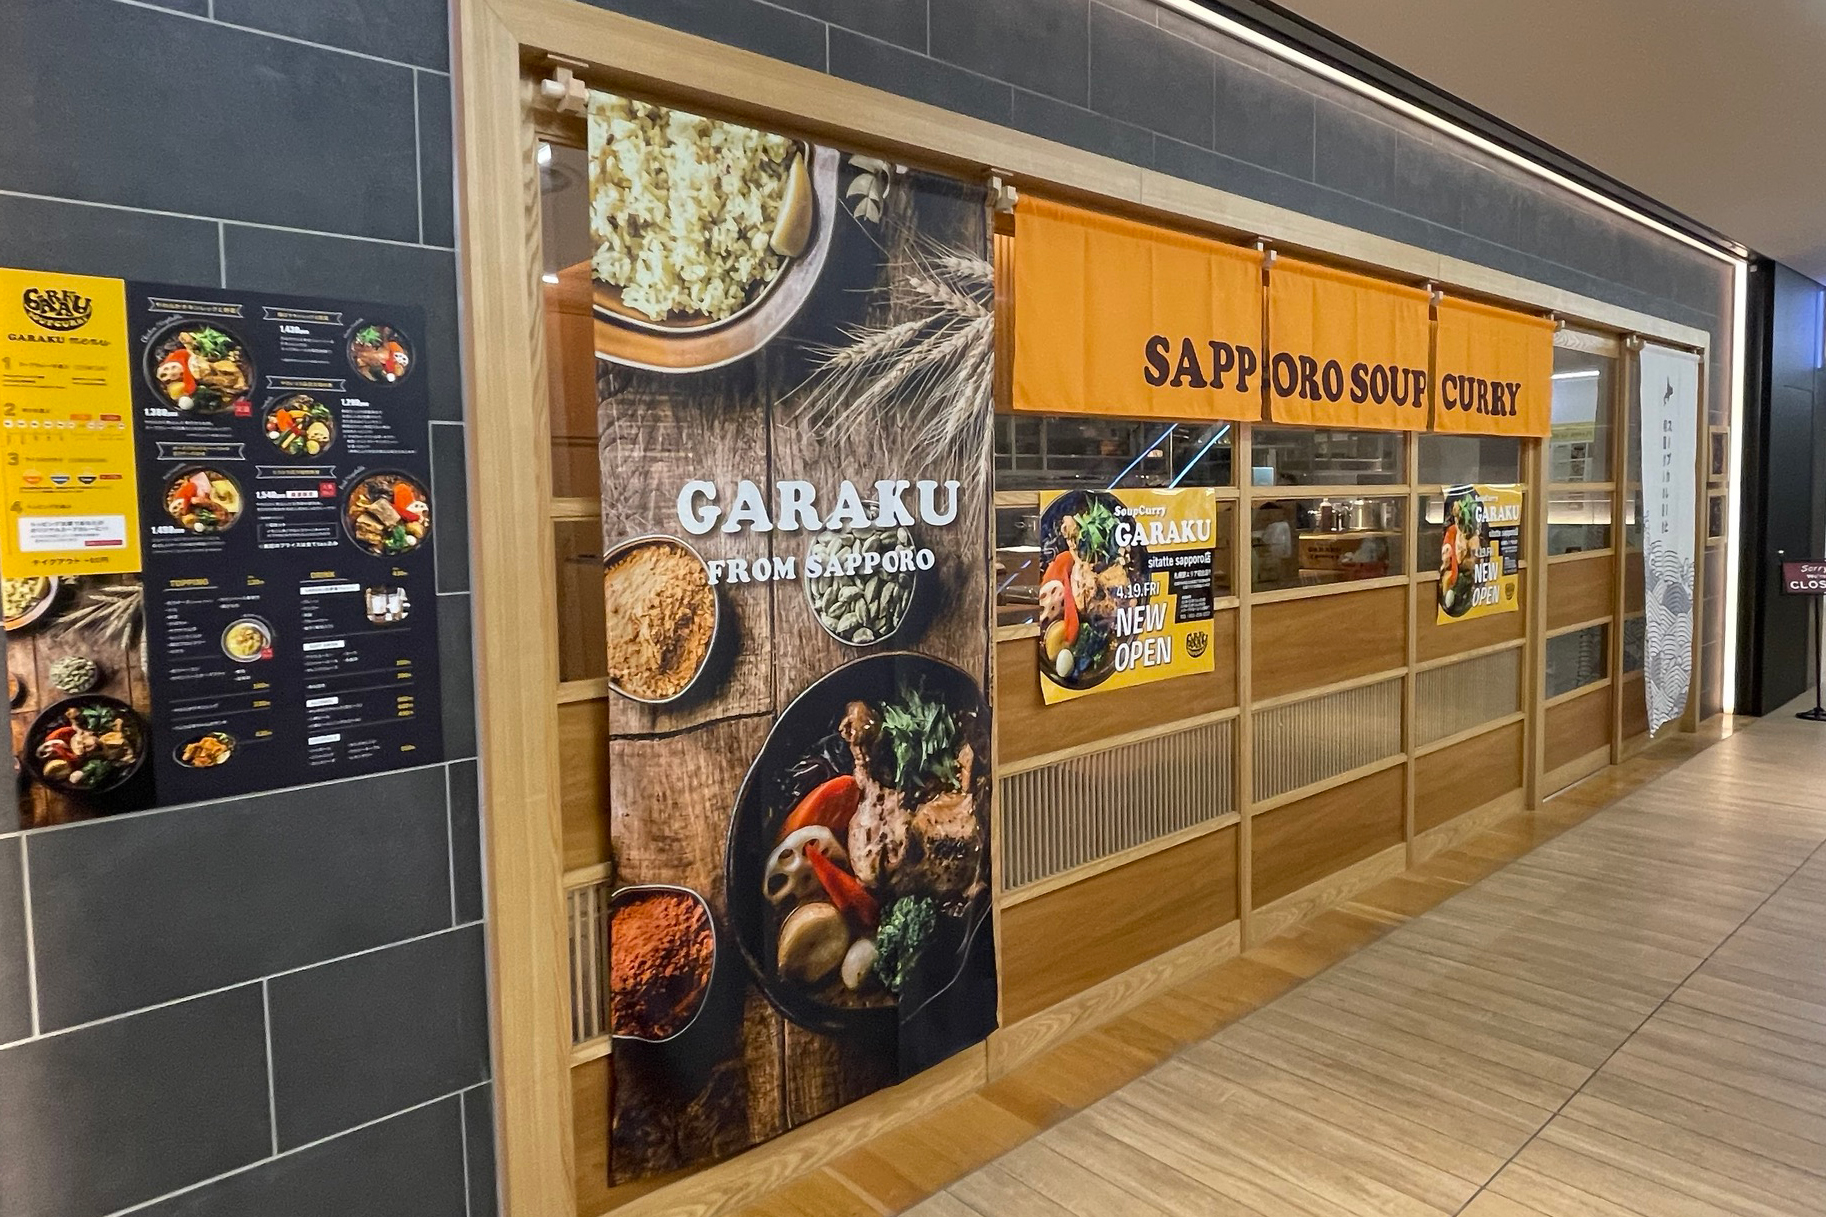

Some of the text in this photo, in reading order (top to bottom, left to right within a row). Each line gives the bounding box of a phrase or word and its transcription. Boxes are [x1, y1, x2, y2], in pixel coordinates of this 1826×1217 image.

[7, 333, 65, 344] GARAKU
[1144, 334, 1522, 417] SAPPORO SOUP CURRY
[8, 452, 19, 466] 3
[677, 479, 961, 536] GARAKU
[1114, 504, 1168, 517] SoupCurry
[1475, 504, 1520, 523] GARAKU
[1115, 518, 1212, 547] GARAKU
[707, 548, 935, 585] FROM SAPPORO
[1148, 555, 1174, 568] sitatte
[1475, 562, 1498, 584] NEW
[1116, 581, 1160, 599] 4.19.FRI
[1472, 585, 1499, 607] OPEN
[1116, 602, 1167, 637] NEW
[1114, 636, 1172, 672] OPEN
